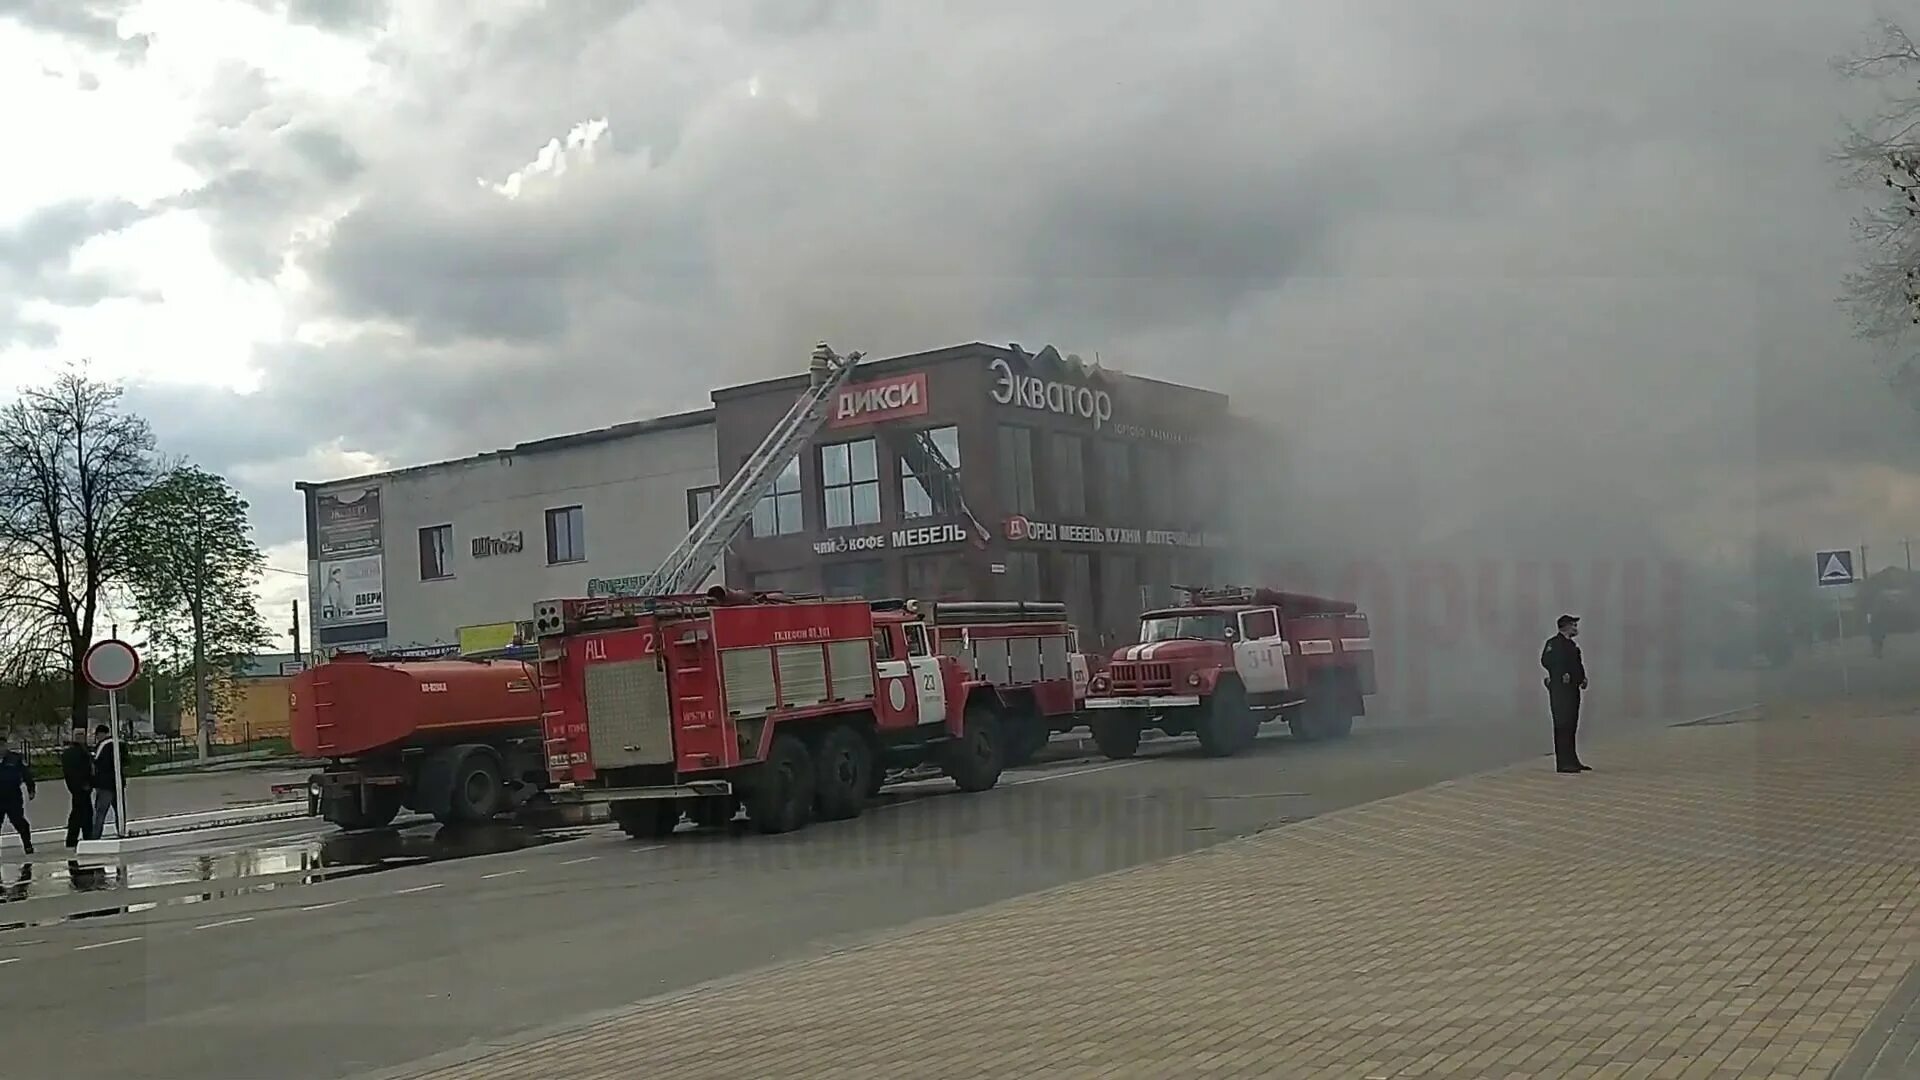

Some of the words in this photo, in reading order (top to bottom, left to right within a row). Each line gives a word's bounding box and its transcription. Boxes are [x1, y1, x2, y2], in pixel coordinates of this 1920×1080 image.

[837, 381, 919, 419] ДИКСИ
[989, 358, 1112, 430] Экватор
[849, 534, 885, 551] КОФЕ
[892, 524, 967, 547] МЕБЕЛЬ
[1059, 526, 1105, 543] МЕБЕЛЬ
[355, 591, 382, 606] ДВЕРИ
[923, 674, 935, 690] 23
